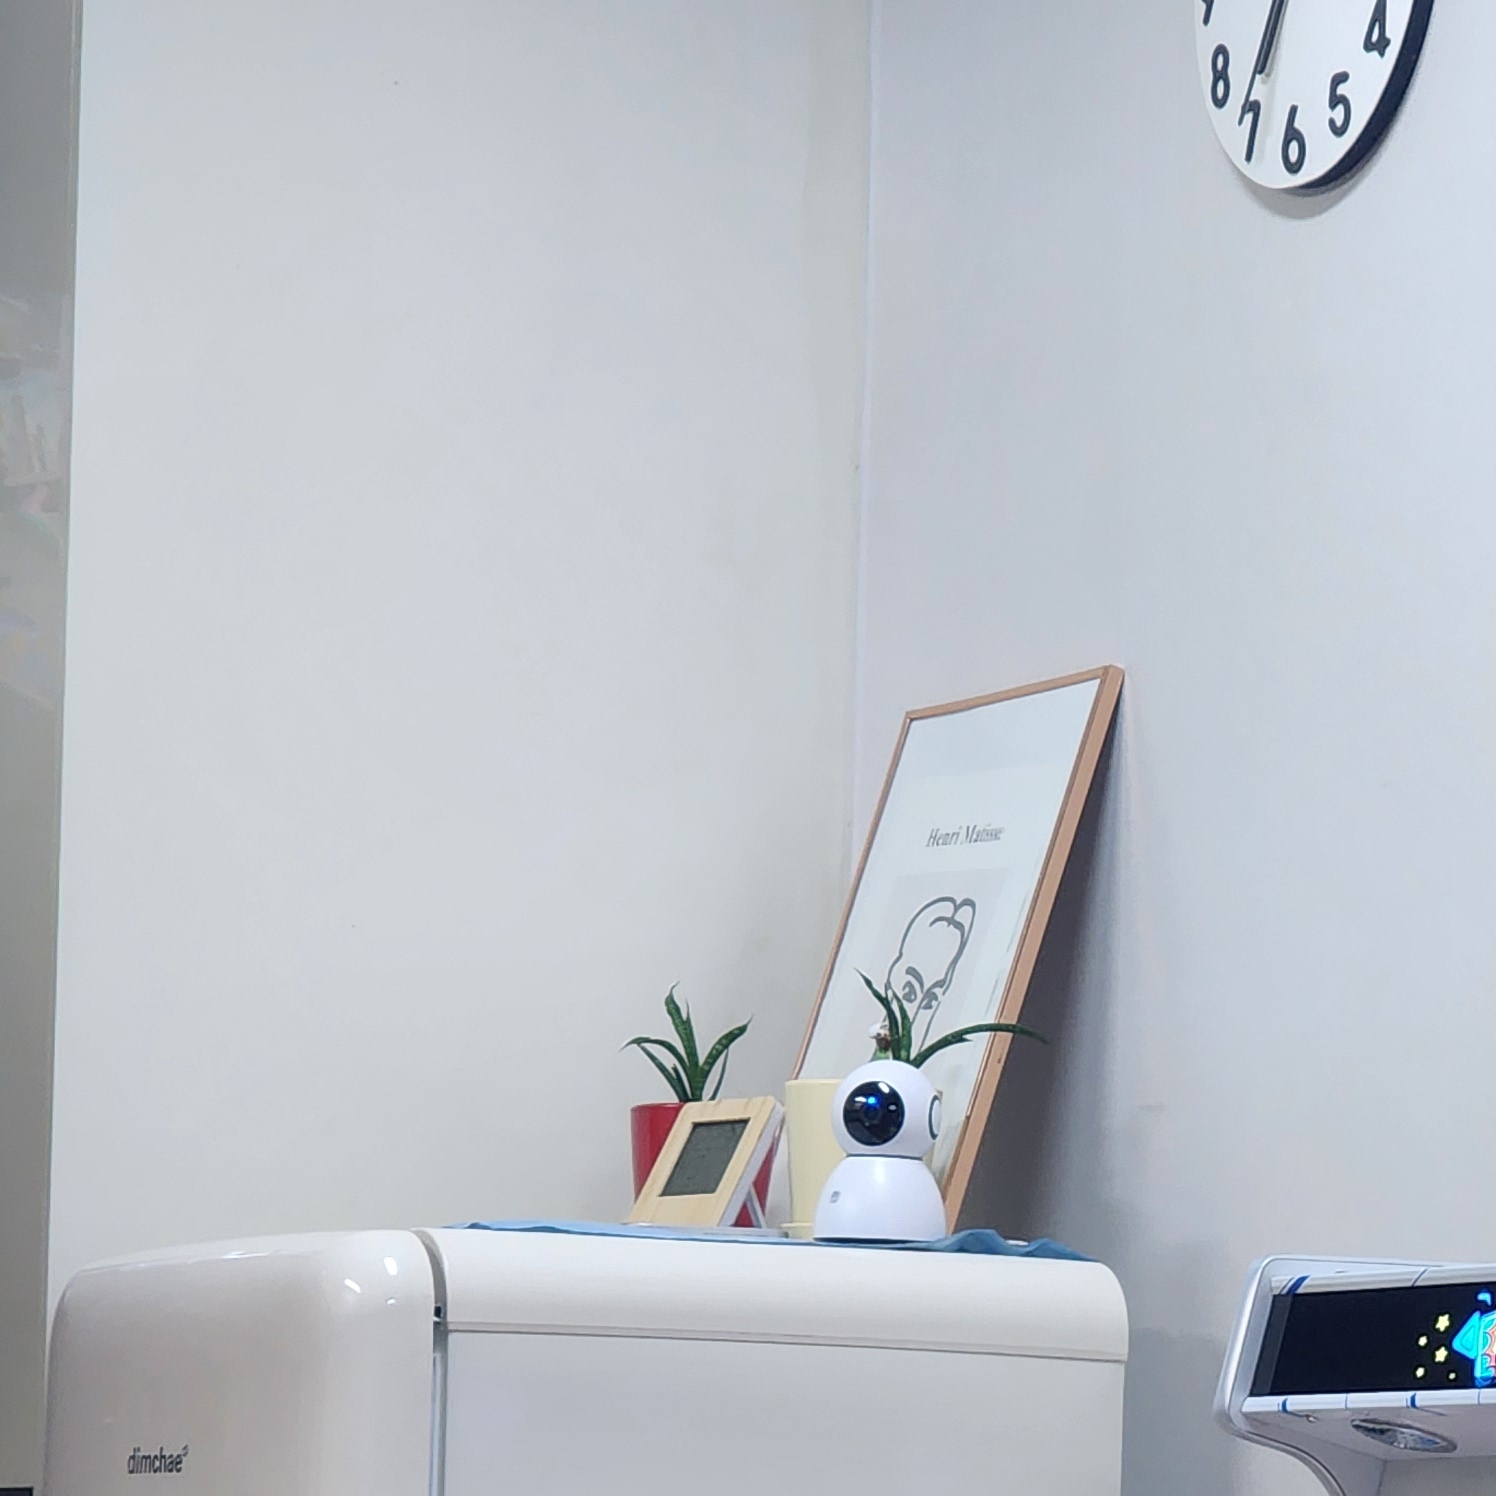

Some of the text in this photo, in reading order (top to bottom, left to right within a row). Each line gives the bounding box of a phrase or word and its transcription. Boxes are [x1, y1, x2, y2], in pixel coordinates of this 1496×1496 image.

[1363, 0, 1391, 58] 4
[1210, 43, 1231, 110] 8
[1327, 70, 1352, 138] 5
[1240, 99, 1261, 163] 7
[1281, 104, 1306, 176] 6
[926, 825, 961, 847] Henri
